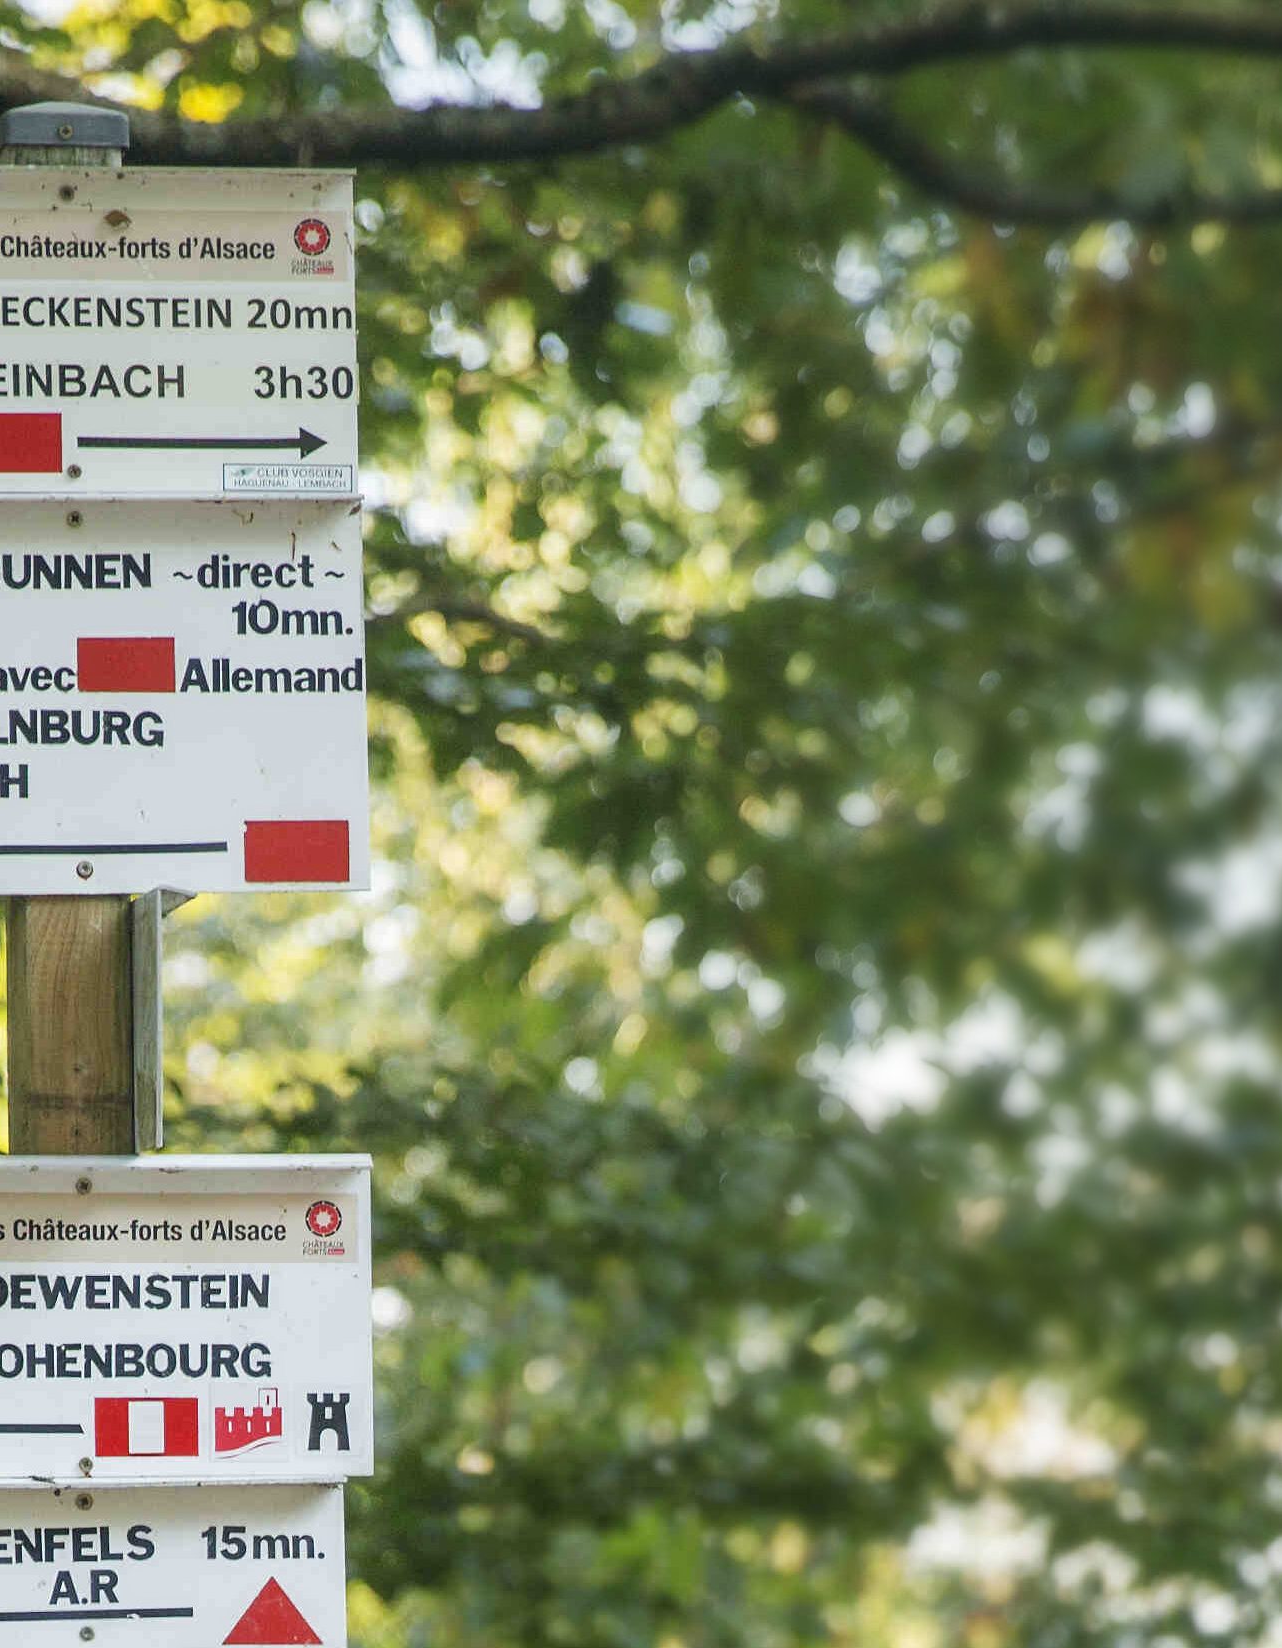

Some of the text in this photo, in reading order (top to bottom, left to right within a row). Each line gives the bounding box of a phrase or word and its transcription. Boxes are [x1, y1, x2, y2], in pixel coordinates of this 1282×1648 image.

[1, 236, 170, 258] Châteaux-forts
[248, 299, 351, 329] 20mn
[255, 366, 353, 399] 3h30
[232, 600, 353, 635] 10mn.
[180, 658, 362, 692] Allemand
[13, 1218, 182, 1240] Châteaux-forts
[50, 1570, 119, 1604] A.R
